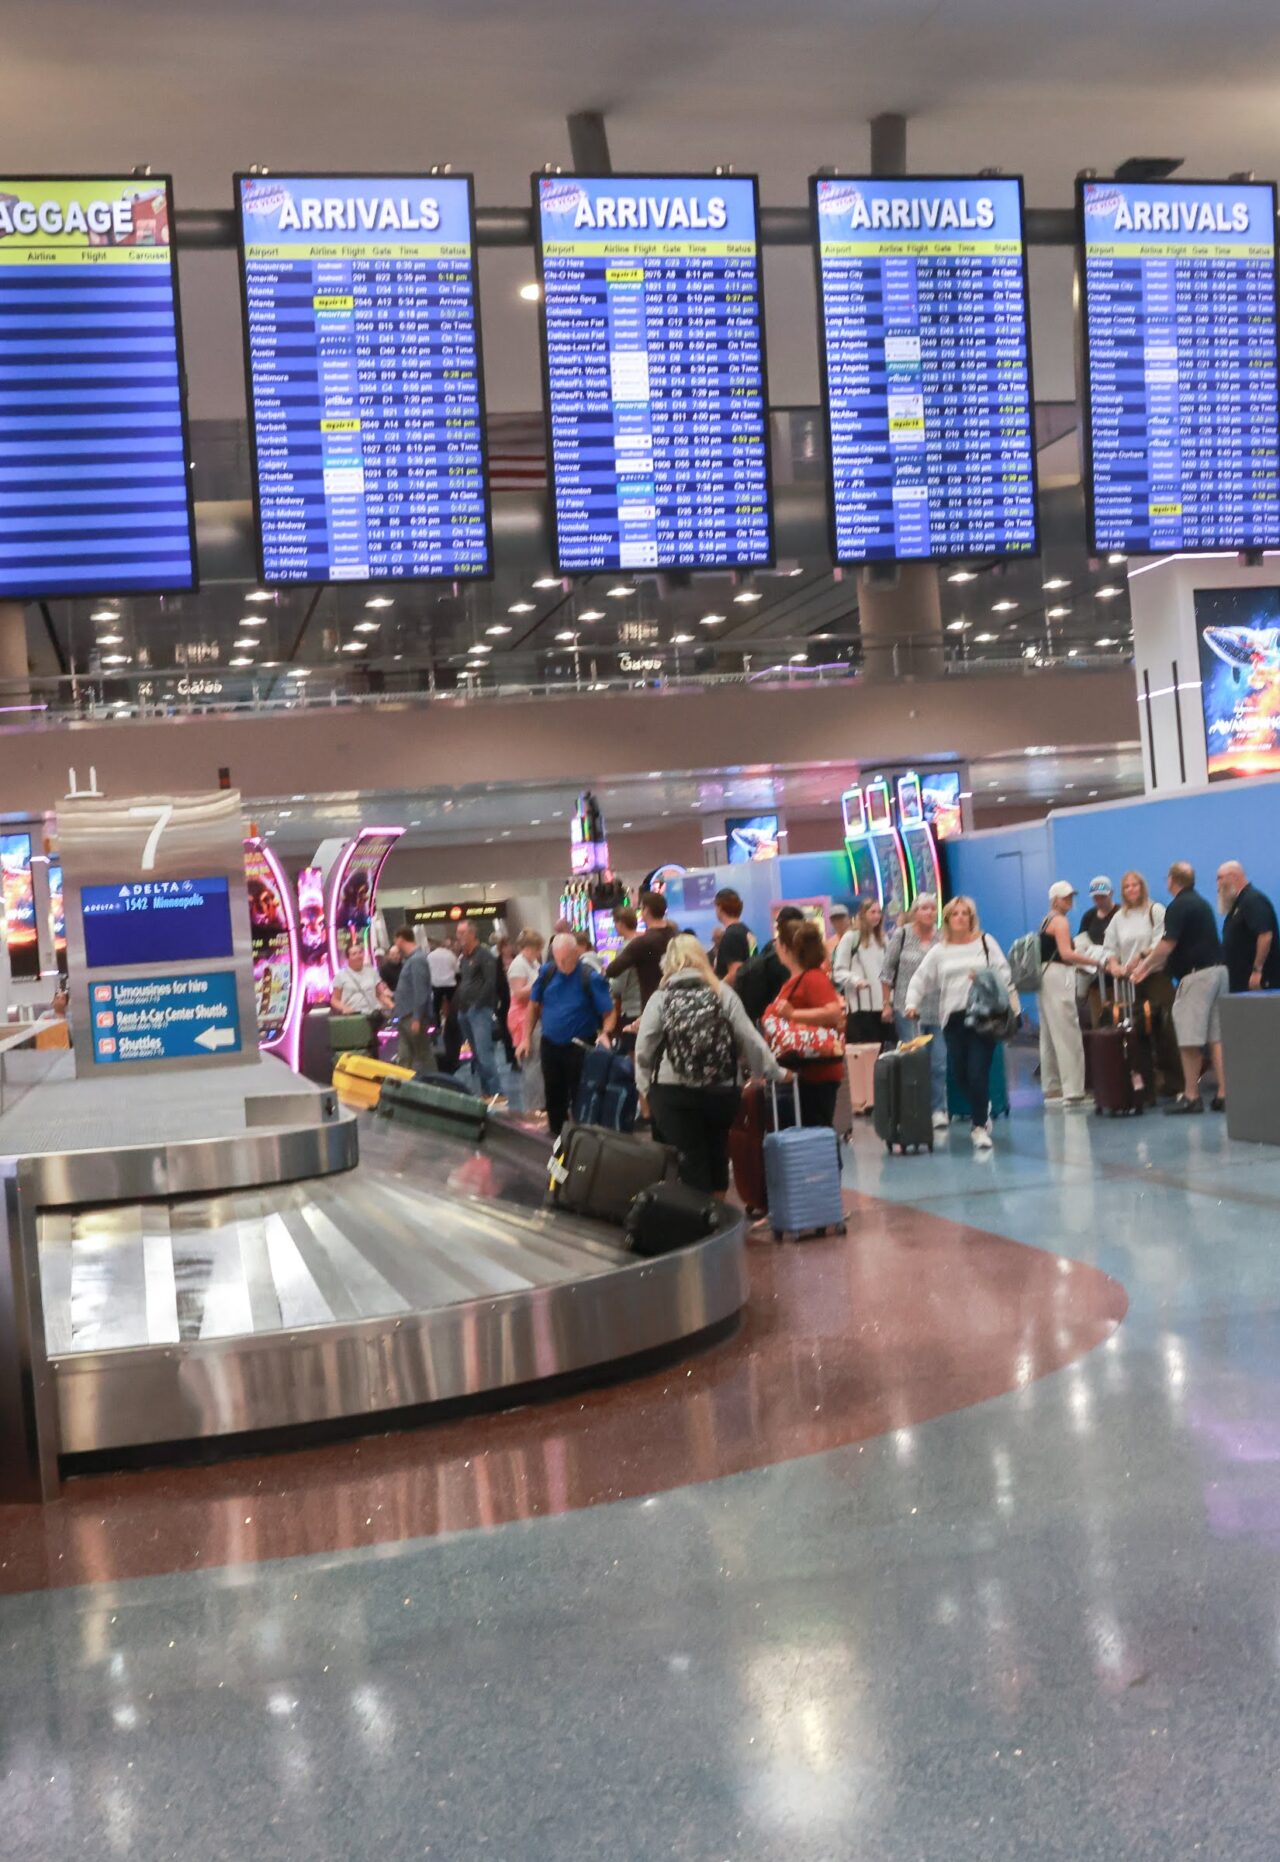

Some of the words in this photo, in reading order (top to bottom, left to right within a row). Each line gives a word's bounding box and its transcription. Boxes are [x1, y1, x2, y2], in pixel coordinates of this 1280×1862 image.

[279, 198, 441, 230] ARRIVALS
[574, 197, 727, 228] ARRIVALS
[851, 199, 994, 228] ARRIVALS
[1114, 202, 1249, 231] ARRIVALS
[249, 248, 279, 257] Airport
[310, 247, 337, 256] Airline
[342, 247, 365, 257] Flight
[373, 247, 391, 255] Gate
[400, 246, 418, 255] Time
[440, 246, 466, 255] Status
[546, 245, 575, 254] Airport
[604, 245, 629, 253] Airline
[634, 244, 656, 254] Flight
[663, 245, 681, 253] Gate
[688, 244, 706, 253] Time
[727, 244, 751, 253] Status
[825, 246, 852, 254] Airport
[879, 245, 903, 253] Airline
[907, 244, 928, 254] Flight
[935, 245, 951, 253] Gate
[959, 245, 975, 253] Time
[994, 244, 1017, 253] Status
[1089, 247, 1114, 255] Airport
[1166, 247, 1187, 256] Flight
[1249, 247, 1270, 255] Status
[28, 252, 56, 261] Airline
[82, 252, 107, 263] Flight
[129, 251, 168, 259] Carousel
[453, 261, 468, 269] Time
[440, 298, 468, 306] Arriving
[458, 346, 473, 354] Time
[253, 373, 289, 381] Baltimore
[325, 396, 353, 405] jetBlue
[460, 394, 476, 402] Time
[749, 482, 764, 490] Time
[128, 805, 172, 871] 7
[133, 882, 179, 895] DELTA
[125, 898, 148, 911] 1542
[153, 894, 203, 909] Minneapolis
[115, 983, 171, 996] Limousines
[173, 981, 187, 993] for
[189, 980, 208, 992] hire
[117, 1009, 165, 1025] Rent-A-Car
[166, 1007, 195, 1020] Center
[196, 1004, 228, 1018] Shuttle
[119, 1036, 162, 1050] Shuttles
